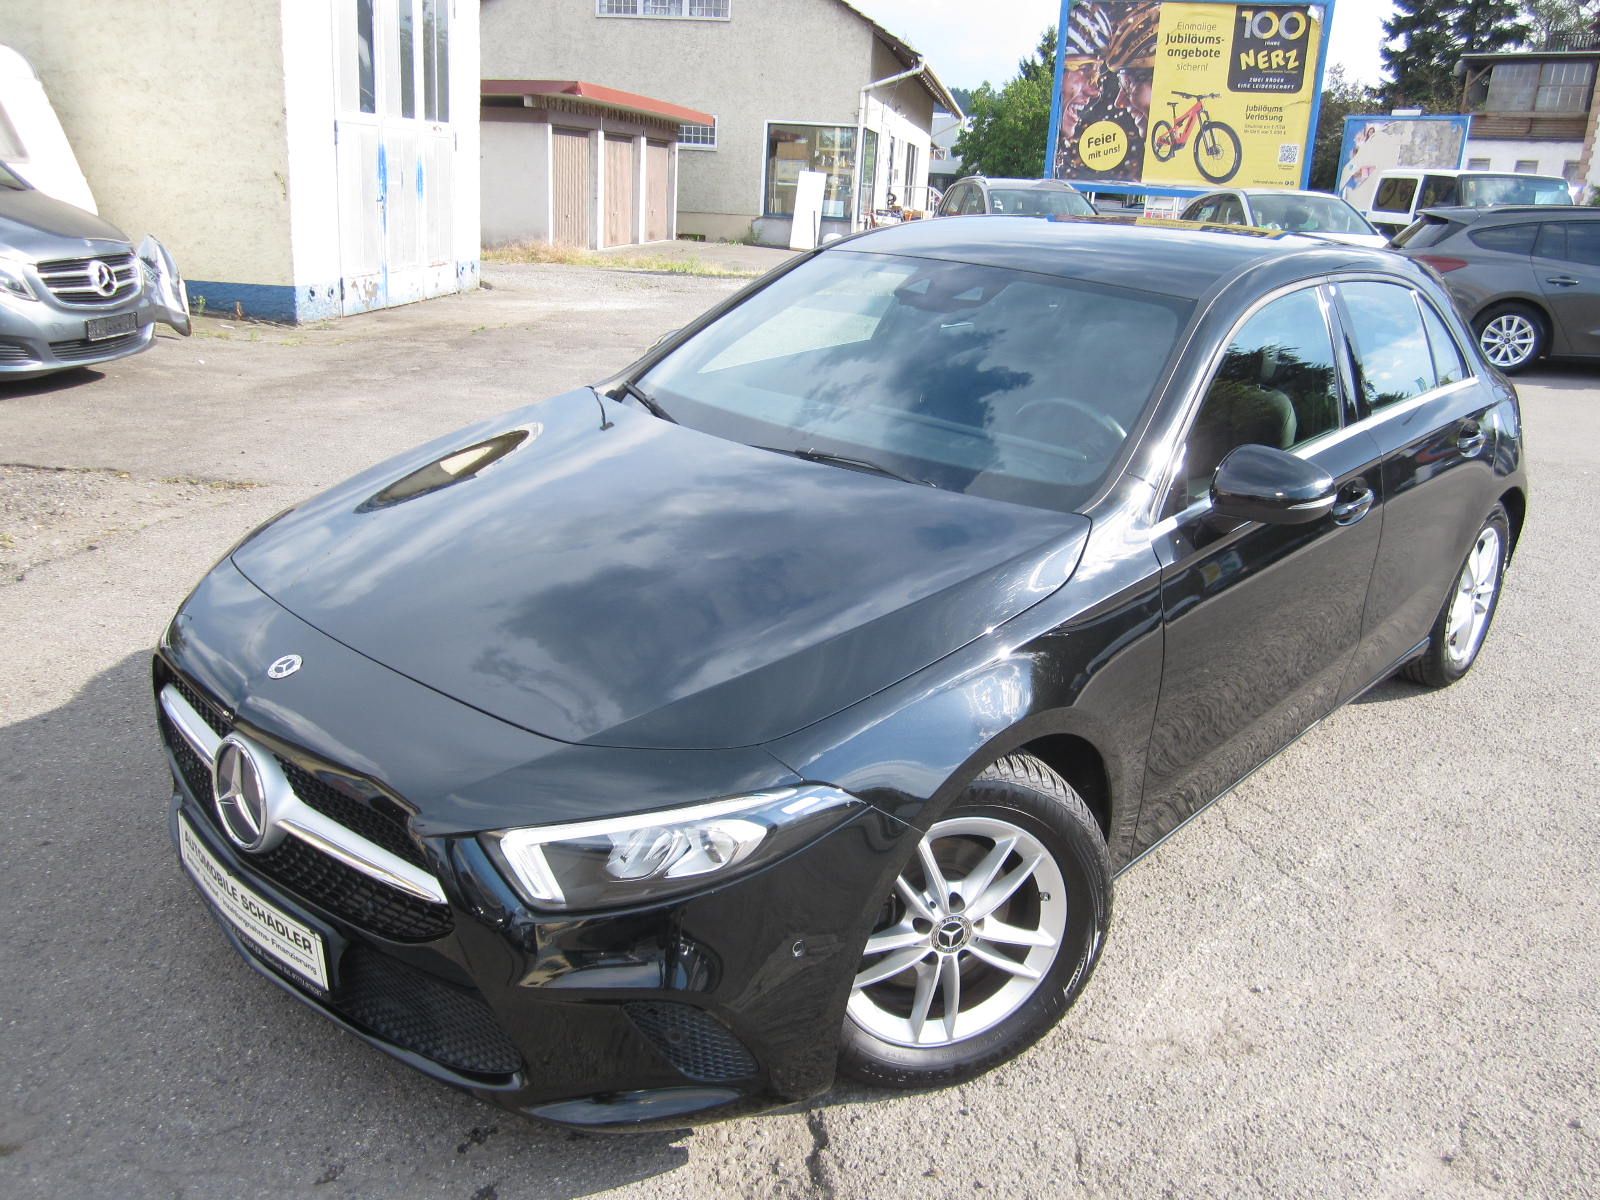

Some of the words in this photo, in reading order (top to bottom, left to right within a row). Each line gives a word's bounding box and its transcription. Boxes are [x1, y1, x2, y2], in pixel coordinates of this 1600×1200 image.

[1176, 21, 1217, 32] Einmalige
[1241, 10, 1307, 40] 100
[1165, 32, 1225, 45] Jubiläums-
[1167, 47, 1221, 59] angebote
[1239, 49, 1299, 70] NERZ
[1176, 61, 1209, 72] sichern!
[1245, 104, 1284, 113] Jubiläums
[1245, 113, 1284, 122] Verlosung
[1087, 132, 1117, 148] Feier
[1088, 150, 1102, 160] mit
[1103, 144, 1121, 156] uns!
[184, 830, 239, 902] AUTOMOBILE
[271, 938, 318, 975] Finanzierung
